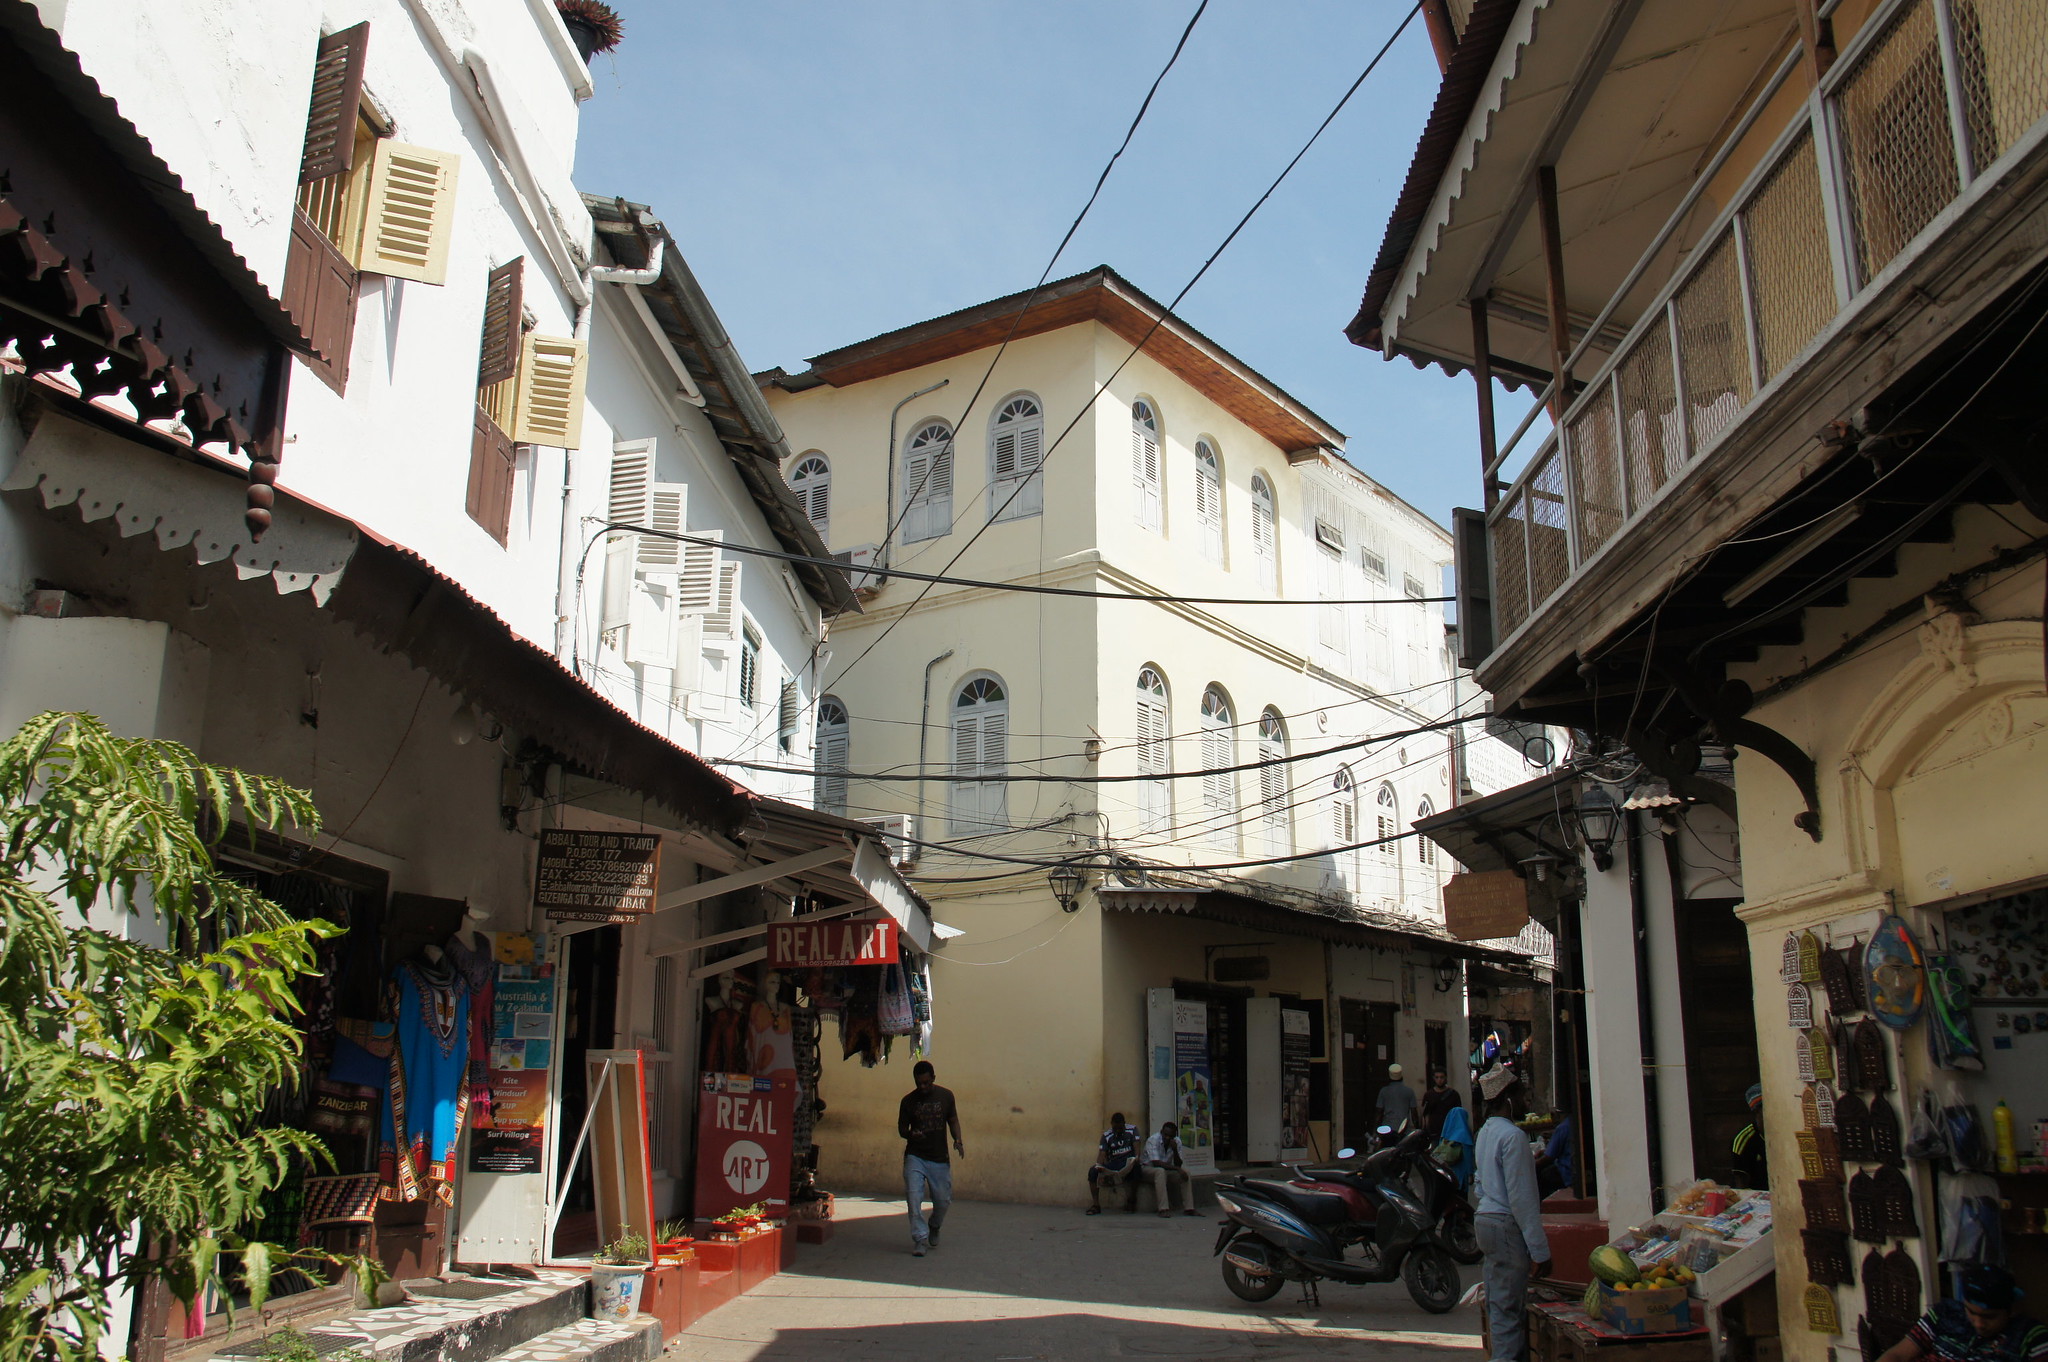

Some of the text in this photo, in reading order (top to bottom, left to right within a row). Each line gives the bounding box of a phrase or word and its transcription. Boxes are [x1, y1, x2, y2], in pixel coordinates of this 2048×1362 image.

[545, 833, 655, 850] ABBAL TOUR AND TRAVEL
[604, 849, 622, 860] 177
[595, 895, 646, 909] ZANZIBAR
[776, 924, 888, 962] REAL ART
[494, 991, 547, 1002] Australia &
[506, 1002, 544, 1012] Zealand
[318, 1096, 368, 1111] ZANZIBAR
[716, 1095, 777, 1135] REAL
[504, 1131, 530, 1140] village
[724, 1156, 768, 1191] ART
